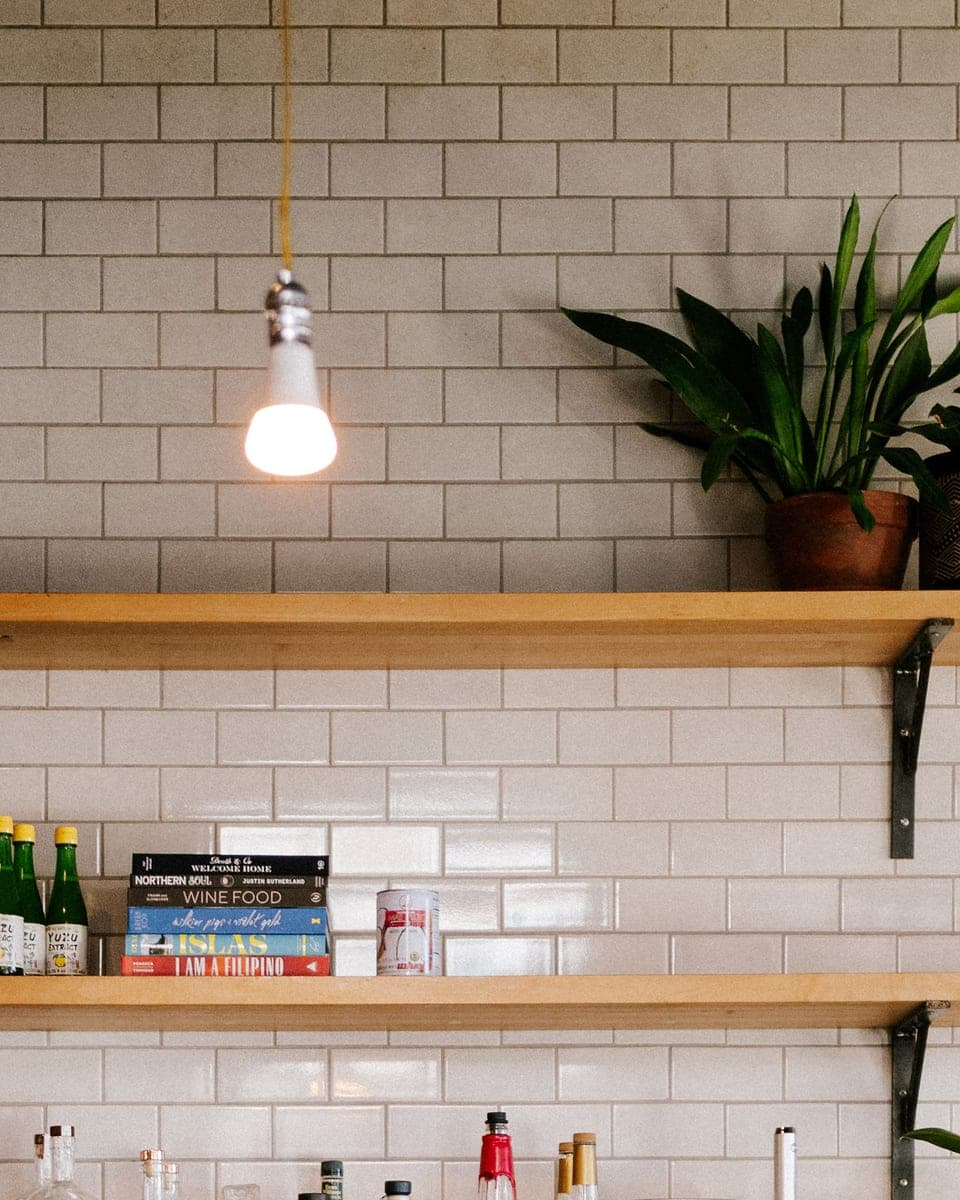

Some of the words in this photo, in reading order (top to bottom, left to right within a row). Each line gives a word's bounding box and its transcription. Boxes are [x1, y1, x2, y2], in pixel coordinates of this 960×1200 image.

[243, 865, 272, 873] HOME
[134, 875, 187, 886] NORTHERN
[188, 875, 213, 886] SOUL
[182, 890, 228, 904] WINE
[232, 890, 282, 904] FOOD
[23, 932, 36, 942] ZU
[48, 932, 78, 942] YUZU
[179, 934, 268, 955] ISLAS
[175, 957, 180, 977] I
[185, 957, 206, 977] AM
[211, 957, 219, 977] A
[224, 956, 284, 977] FILIPINO
